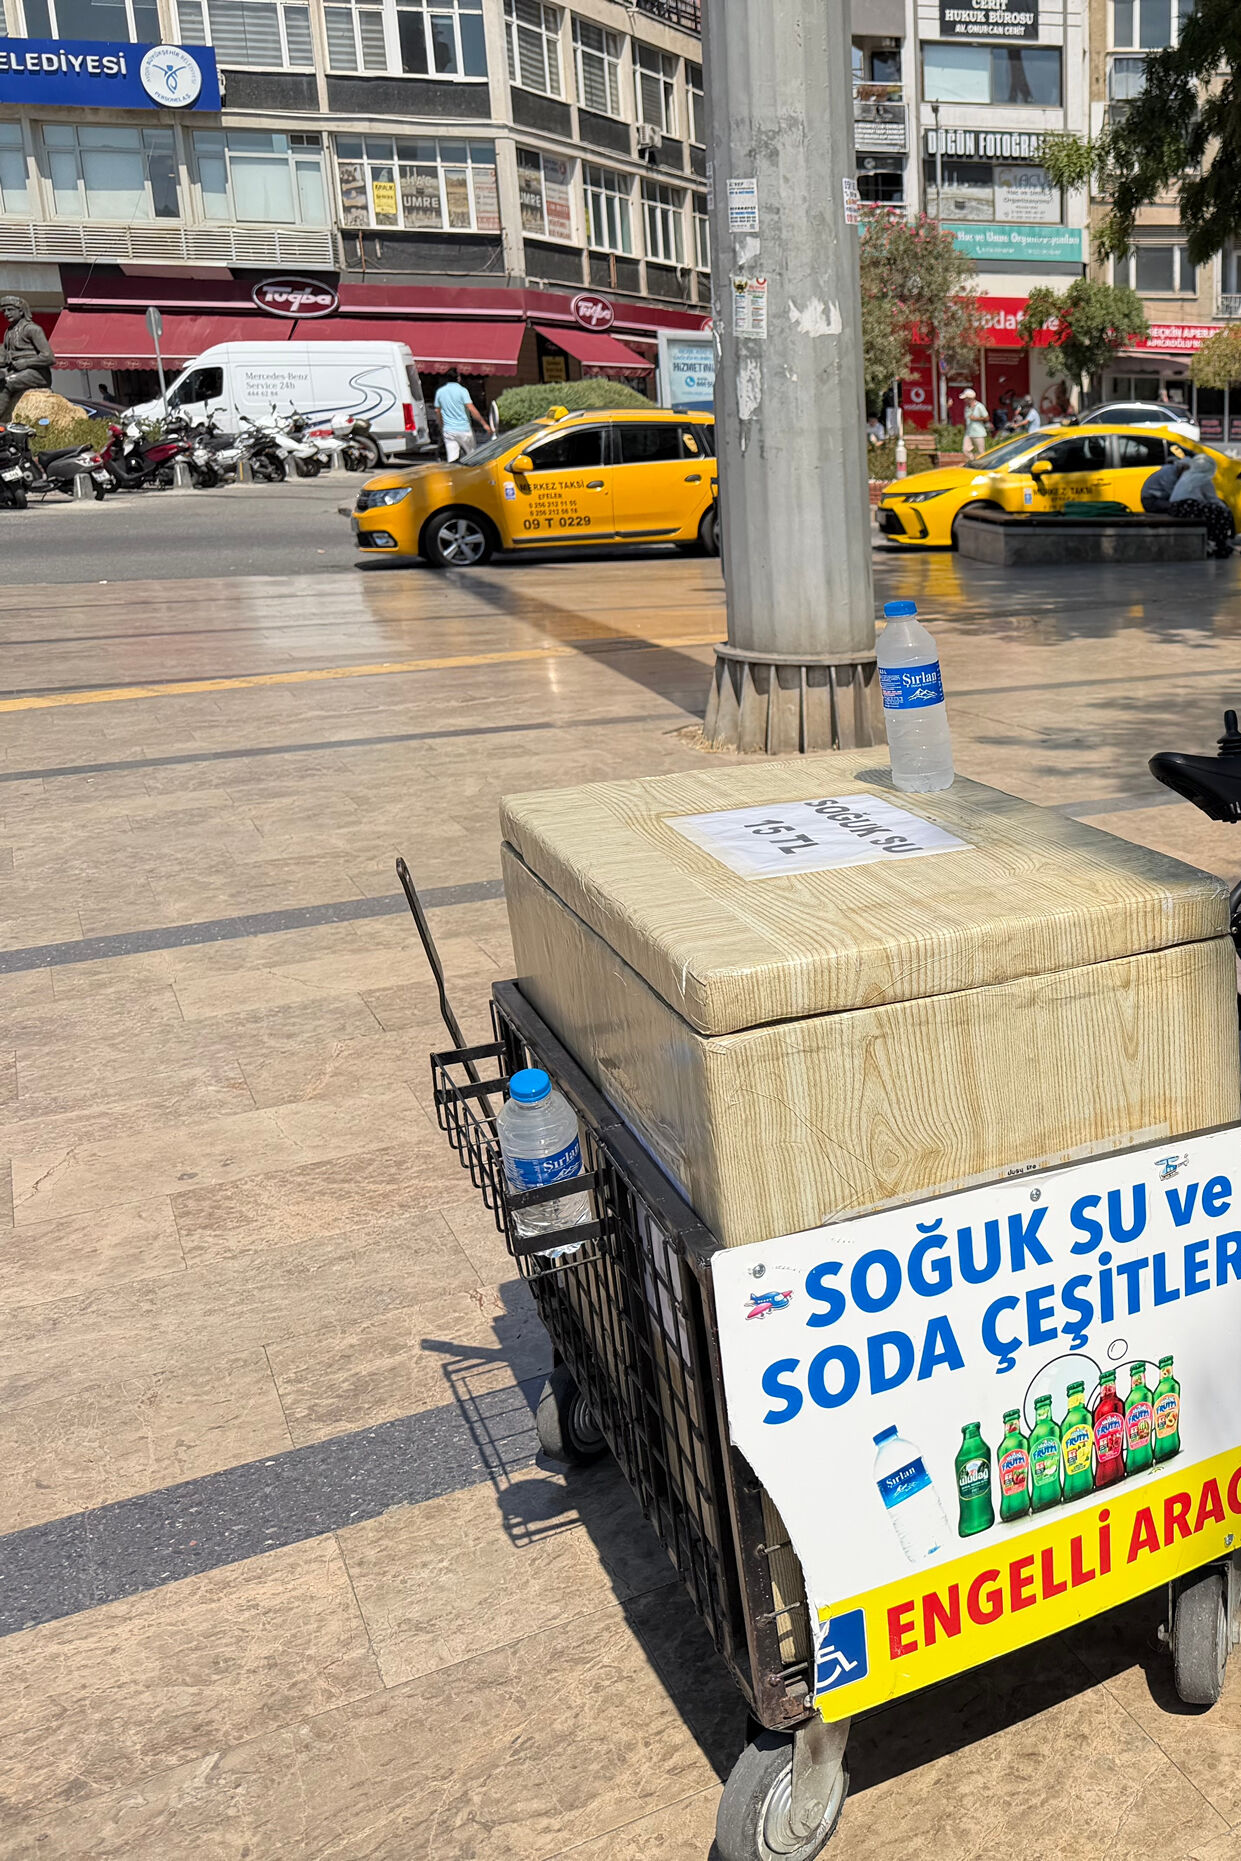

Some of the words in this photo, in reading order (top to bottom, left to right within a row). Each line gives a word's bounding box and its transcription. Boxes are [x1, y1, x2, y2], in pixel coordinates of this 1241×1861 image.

[945, 9, 986, 22] HUKUK
[989, 11, 1034, 24] BÜROSU
[0, 49, 127, 75] ELEDİYESİ
[927, 131, 975, 155] DÜĞÜN
[403, 196, 439, 209] UMRE
[520, 482, 557, 491] MERKEZ
[558, 479, 585, 489] TAKSİ
[523, 519, 540, 530] 09
[544, 518, 553, 528] T
[559, 515, 591, 528] 0229
[902, 671, 937, 688] Şırlan
[743, 818, 796, 836] 15
[803, 799, 892, 838] SOĞUK
[874, 833, 925, 854] SU
[769, 833, 820, 855] TL
[543, 1142, 579, 1173] Şırlan
[805, 1207, 1054, 1328] SOĞUK
[1070, 1183, 1147, 1255] SU
[1165, 1175, 1232, 1227] ve
[762, 1315, 965, 1425] SODA
[887, 1509, 1112, 1660] ENGELLİ
